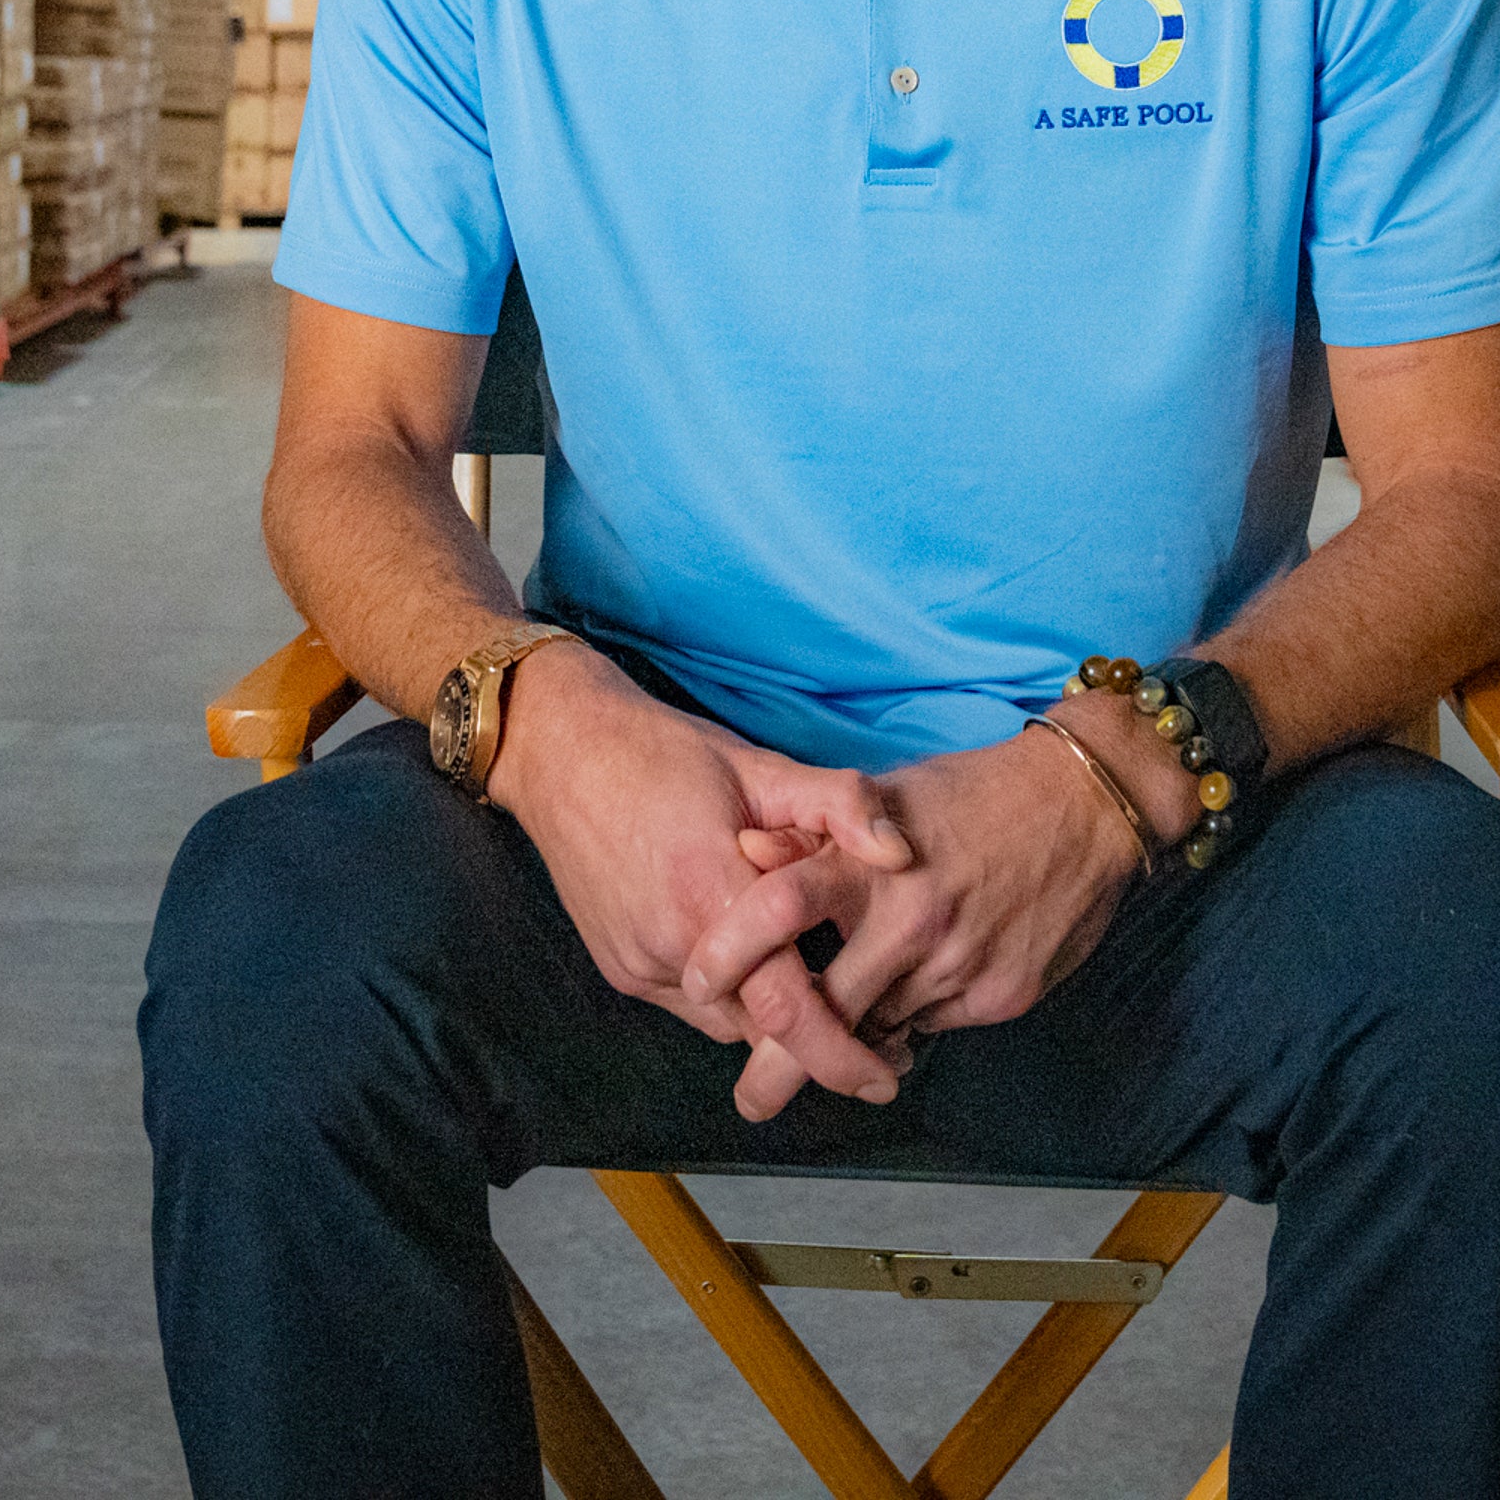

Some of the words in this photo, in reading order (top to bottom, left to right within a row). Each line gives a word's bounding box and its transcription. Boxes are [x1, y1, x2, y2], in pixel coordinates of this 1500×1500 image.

[1034, 109, 1055, 129] A
[1061, 106, 1129, 128] SAFE
[1137, 102, 1213, 126] POOL
